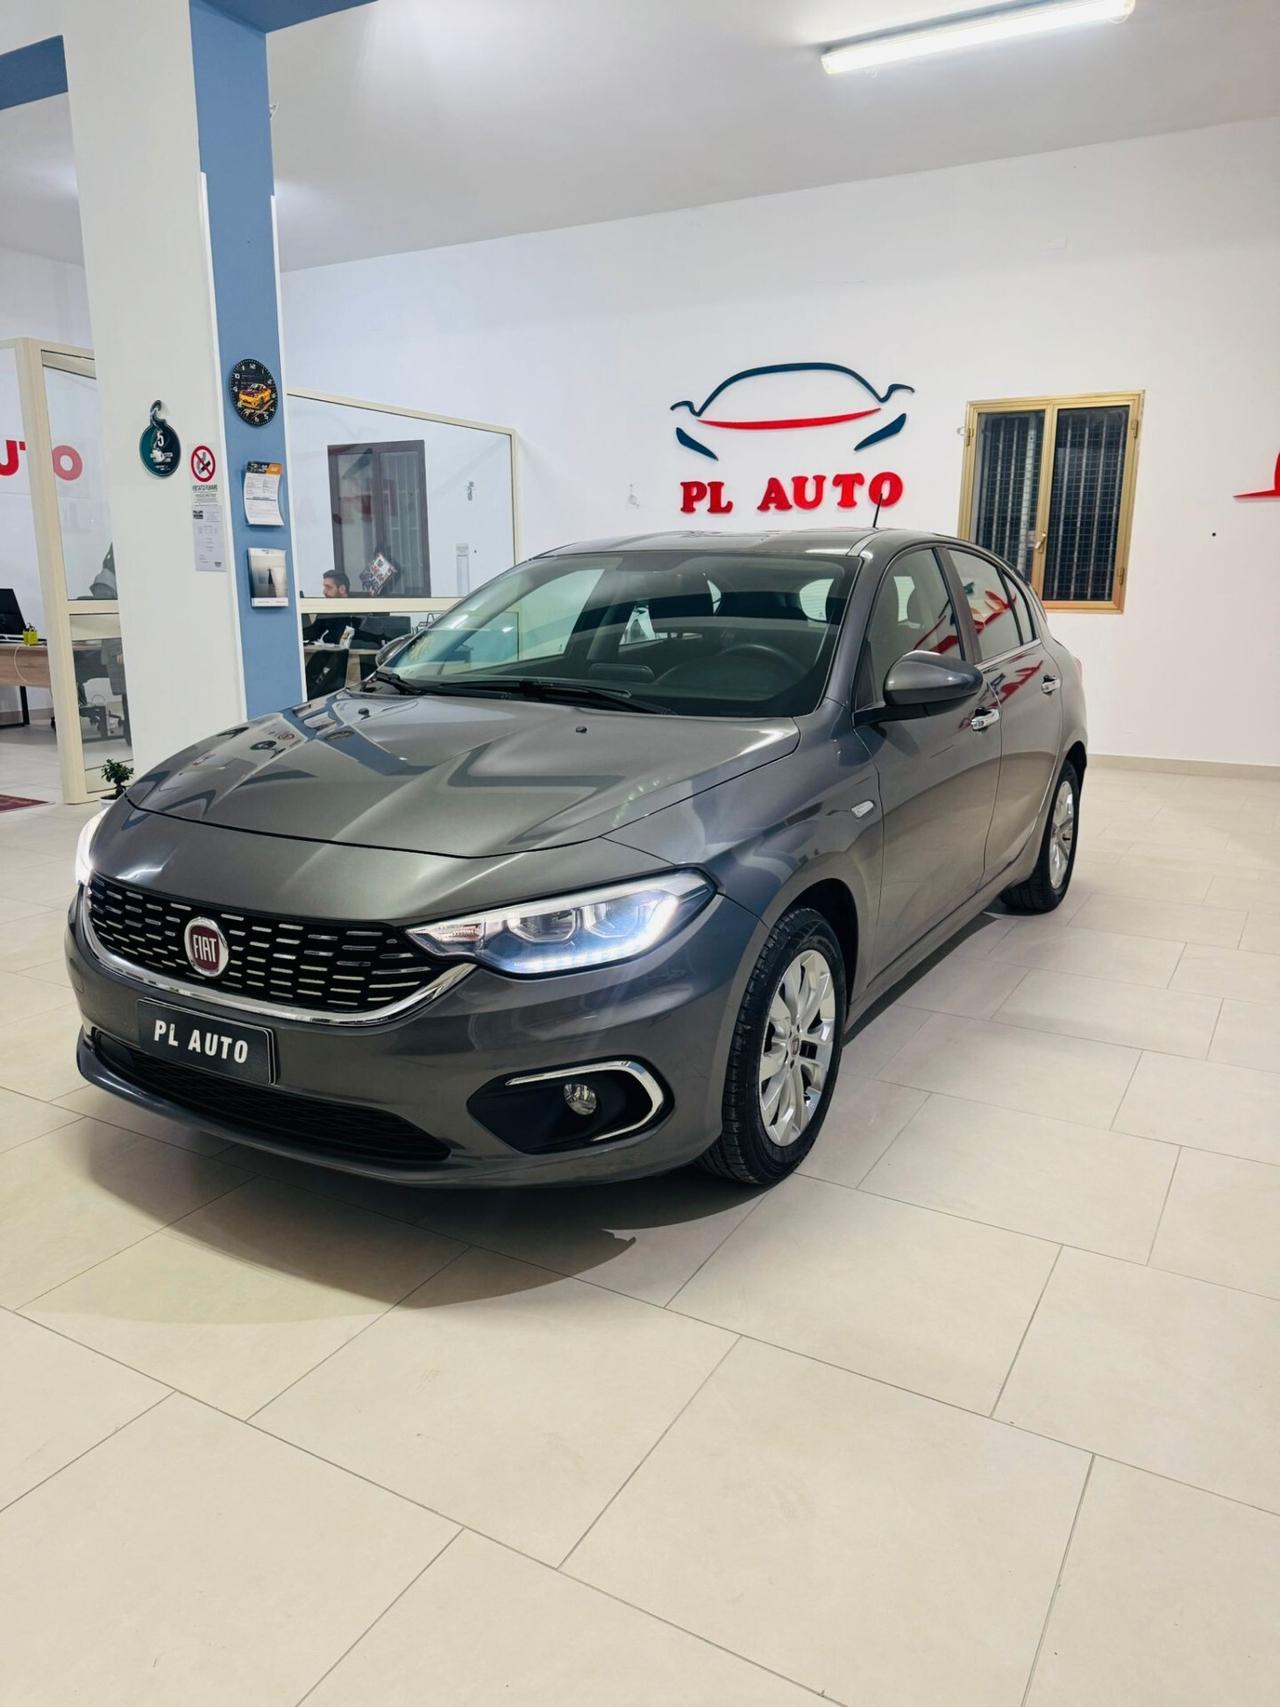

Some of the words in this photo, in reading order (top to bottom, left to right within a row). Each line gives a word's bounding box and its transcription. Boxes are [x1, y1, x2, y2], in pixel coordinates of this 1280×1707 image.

[680, 481, 733, 513] PL
[757, 472, 903, 511] AUTO
[192, 934, 217, 963] FIAT
[154, 1019, 179, 1047] PL
[188, 1029, 248, 1064] AUTO
